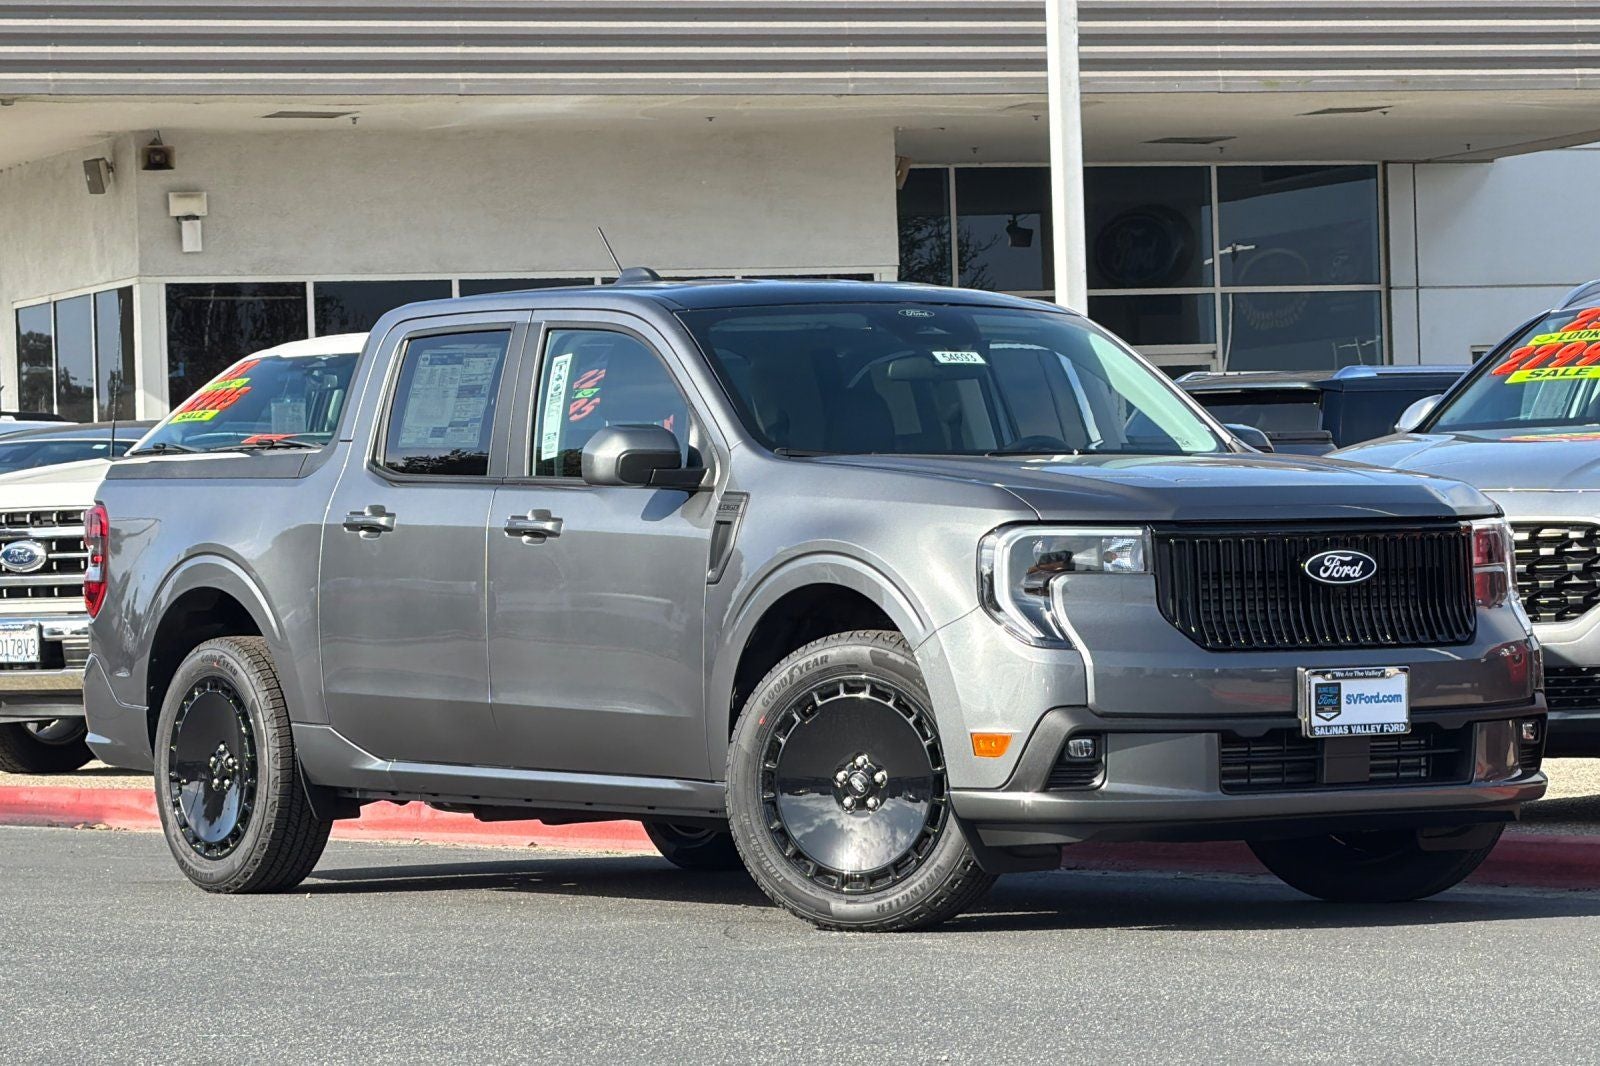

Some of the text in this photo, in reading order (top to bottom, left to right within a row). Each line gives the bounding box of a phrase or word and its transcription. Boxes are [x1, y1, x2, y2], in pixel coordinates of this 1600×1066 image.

[1526, 368, 1593, 379] SALE
[8, 548, 31, 562] Ford
[1319, 554, 1364, 578] Ford
[761, 654, 829, 708] GOODYEAR
[1317, 694, 1339, 705] Ford
[1345, 692, 1403, 705] SVFord.com
[1314, 723, 1406, 736] SALINAS VALLEY FORD
